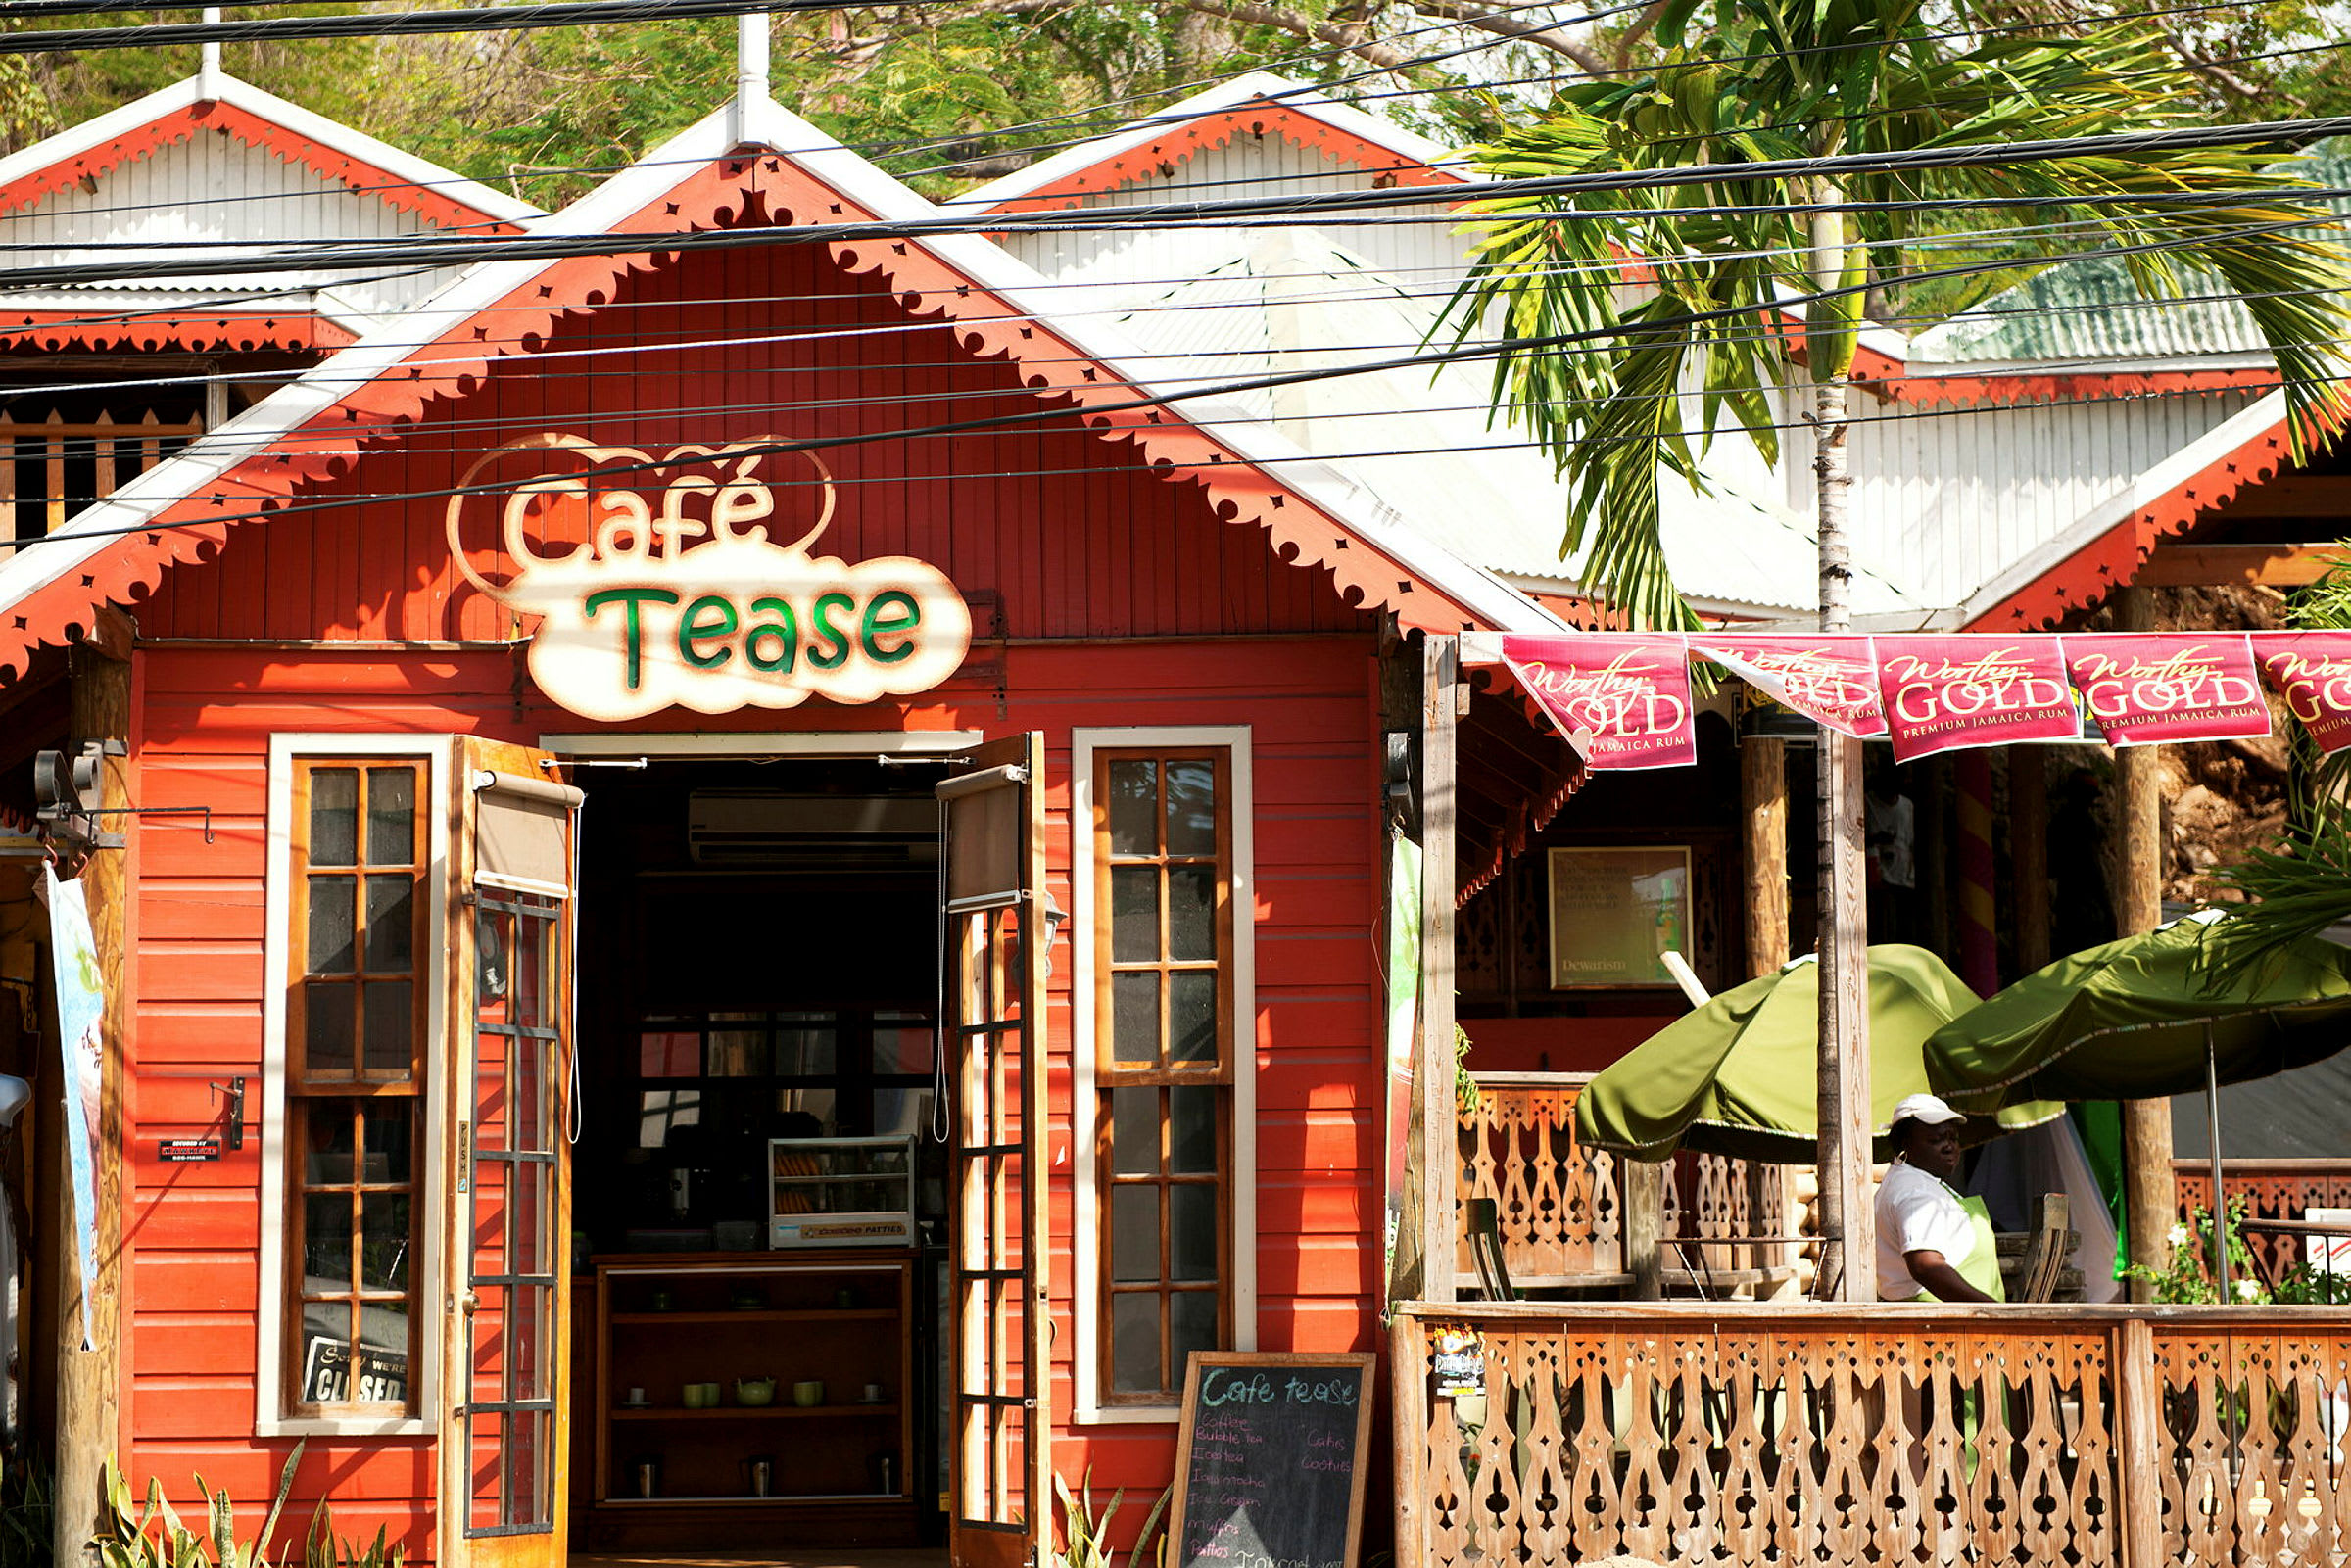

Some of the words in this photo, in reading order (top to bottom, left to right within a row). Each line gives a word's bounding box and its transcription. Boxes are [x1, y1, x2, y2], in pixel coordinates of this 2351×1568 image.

[504, 454, 774, 562] Café
[585, 587, 921, 689] Tease
[1884, 646, 2035, 700] Worthy
[2073, 645, 2225, 700] Worthy
[2265, 651, 2351, 683] Wor
[1567, 694, 1685, 736] OLD
[1796, 700, 1843, 718] AMAICA
[1847, 709, 1877, 720] RUM
[1896, 678, 2064, 723] GOLD
[2087, 676, 2255, 717] GOLD
[2285, 676, 2351, 722] GO
[1903, 720, 1966, 739] PREMIUM
[1973, 711, 2033, 727] JAMAICA
[2039, 709, 2068, 720] RUM
[2099, 715, 2158, 730] REMIUM
[2165, 709, 2224, 724] JAMAICA
[2231, 706, 2261, 718] RUM
[2312, 716, 2351, 736] EMIUM
[1592, 739, 1651, 755] JAMAICA
[1656, 736, 1686, 747] RUM
[1202, 1368, 1274, 1407] Cafe
[1284, 1376, 1357, 1407] tease
